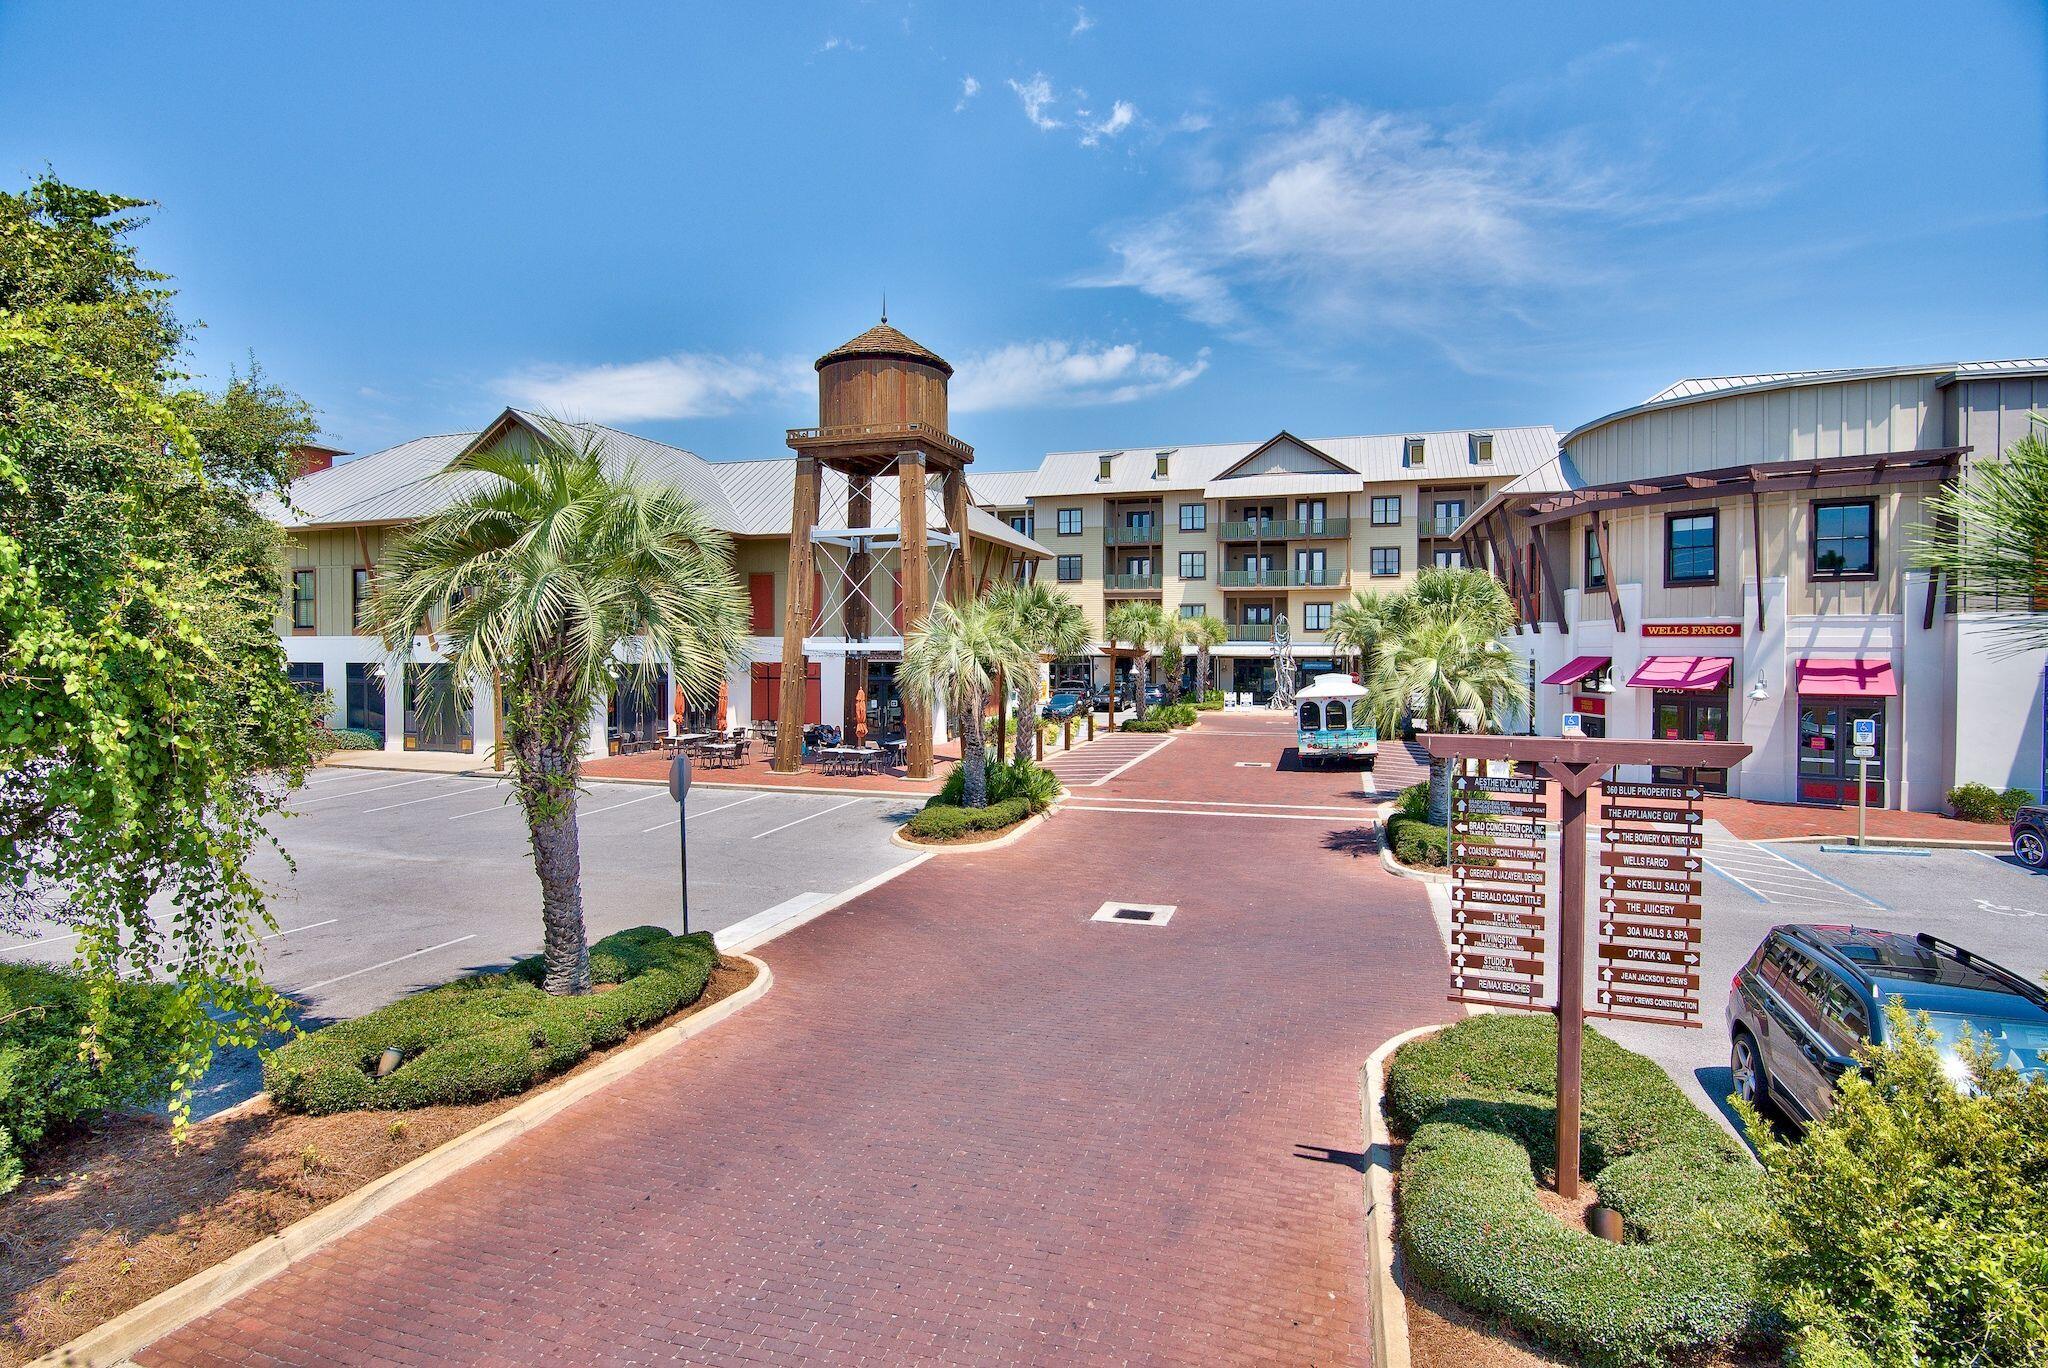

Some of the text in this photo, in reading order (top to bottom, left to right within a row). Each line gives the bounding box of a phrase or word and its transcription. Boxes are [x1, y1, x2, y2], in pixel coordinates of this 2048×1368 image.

[1647, 626, 1734, 635] WELLS FARGO
[1474, 778, 1540, 790] AESTHETIC CLINIQUE
[1606, 786, 1682, 798] 360 BLUE PROPERTIES
[1608, 808, 1678, 820] THE APPLIANCE GUY
[1469, 822, 1486, 831] BRAD
[1486, 822, 1520, 833] CONGLETON
[1534, 825, 1545, 834] INC.
[1622, 832, 1700, 846] THE BOWERY ON THIRTY-A
[1468, 846, 1544, 860] COASTAL SPECIALTY PHARMACY
[1622, 856, 1669, 867] WELLS FARGO
[1469, 868, 1494, 878] GREGORY
[1494, 870, 1498, 879] D
[1524, 872, 1543, 882] DESIGN
[1626, 880, 1690, 892] SKYEBLU SALON
[1472, 891, 1542, 905] EMERALD COAST TITLE
[1626, 902, 1674, 914] THE JUICERY
[1473, 919, 1540, 930] ENVIRONMENTAL CONSULTANTS
[1508, 914, 1520, 923] INC.
[1626, 926, 1688, 940] 30A NAILS & SPA
[1474, 941, 1499, 949] FINANCIAL
[1480, 934, 1518, 945] LIVINGSTON
[1628, 948, 1671, 962] OPTIKK 30A
[1482, 964, 1515, 972] ARCHITECTURE
[1483, 956, 1514, 968] STUDIO A
[1620, 972, 1688, 986] JEAN JACKSON CREWS
[1478, 980, 1530, 994] RE/MAX BEACHES
[1616, 994, 1698, 1010] TERRY CREWS CONSTRUCTION
